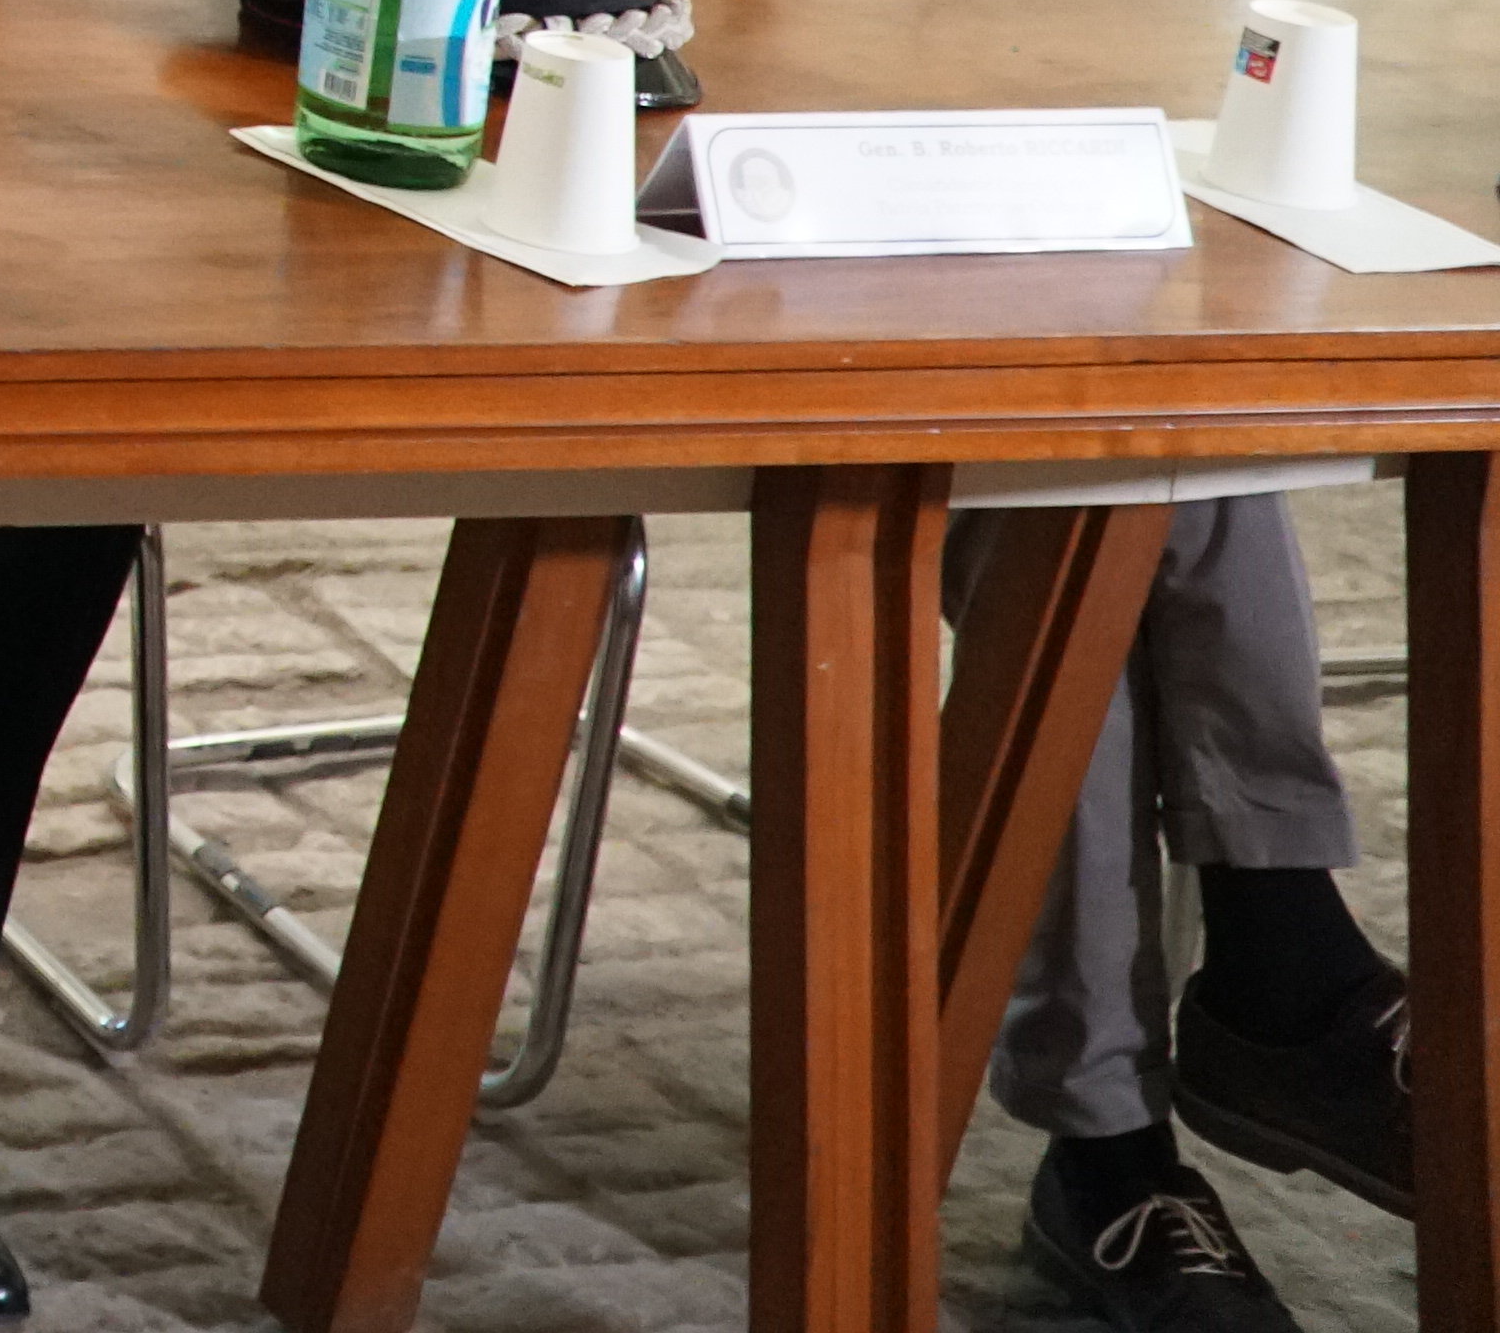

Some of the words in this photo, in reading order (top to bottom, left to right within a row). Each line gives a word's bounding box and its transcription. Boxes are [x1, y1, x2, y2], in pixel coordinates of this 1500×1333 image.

[857, 139, 905, 158] Gen.
[937, 138, 1019, 157] Roberto
[1025, 138, 1127, 157] RICCARDI
